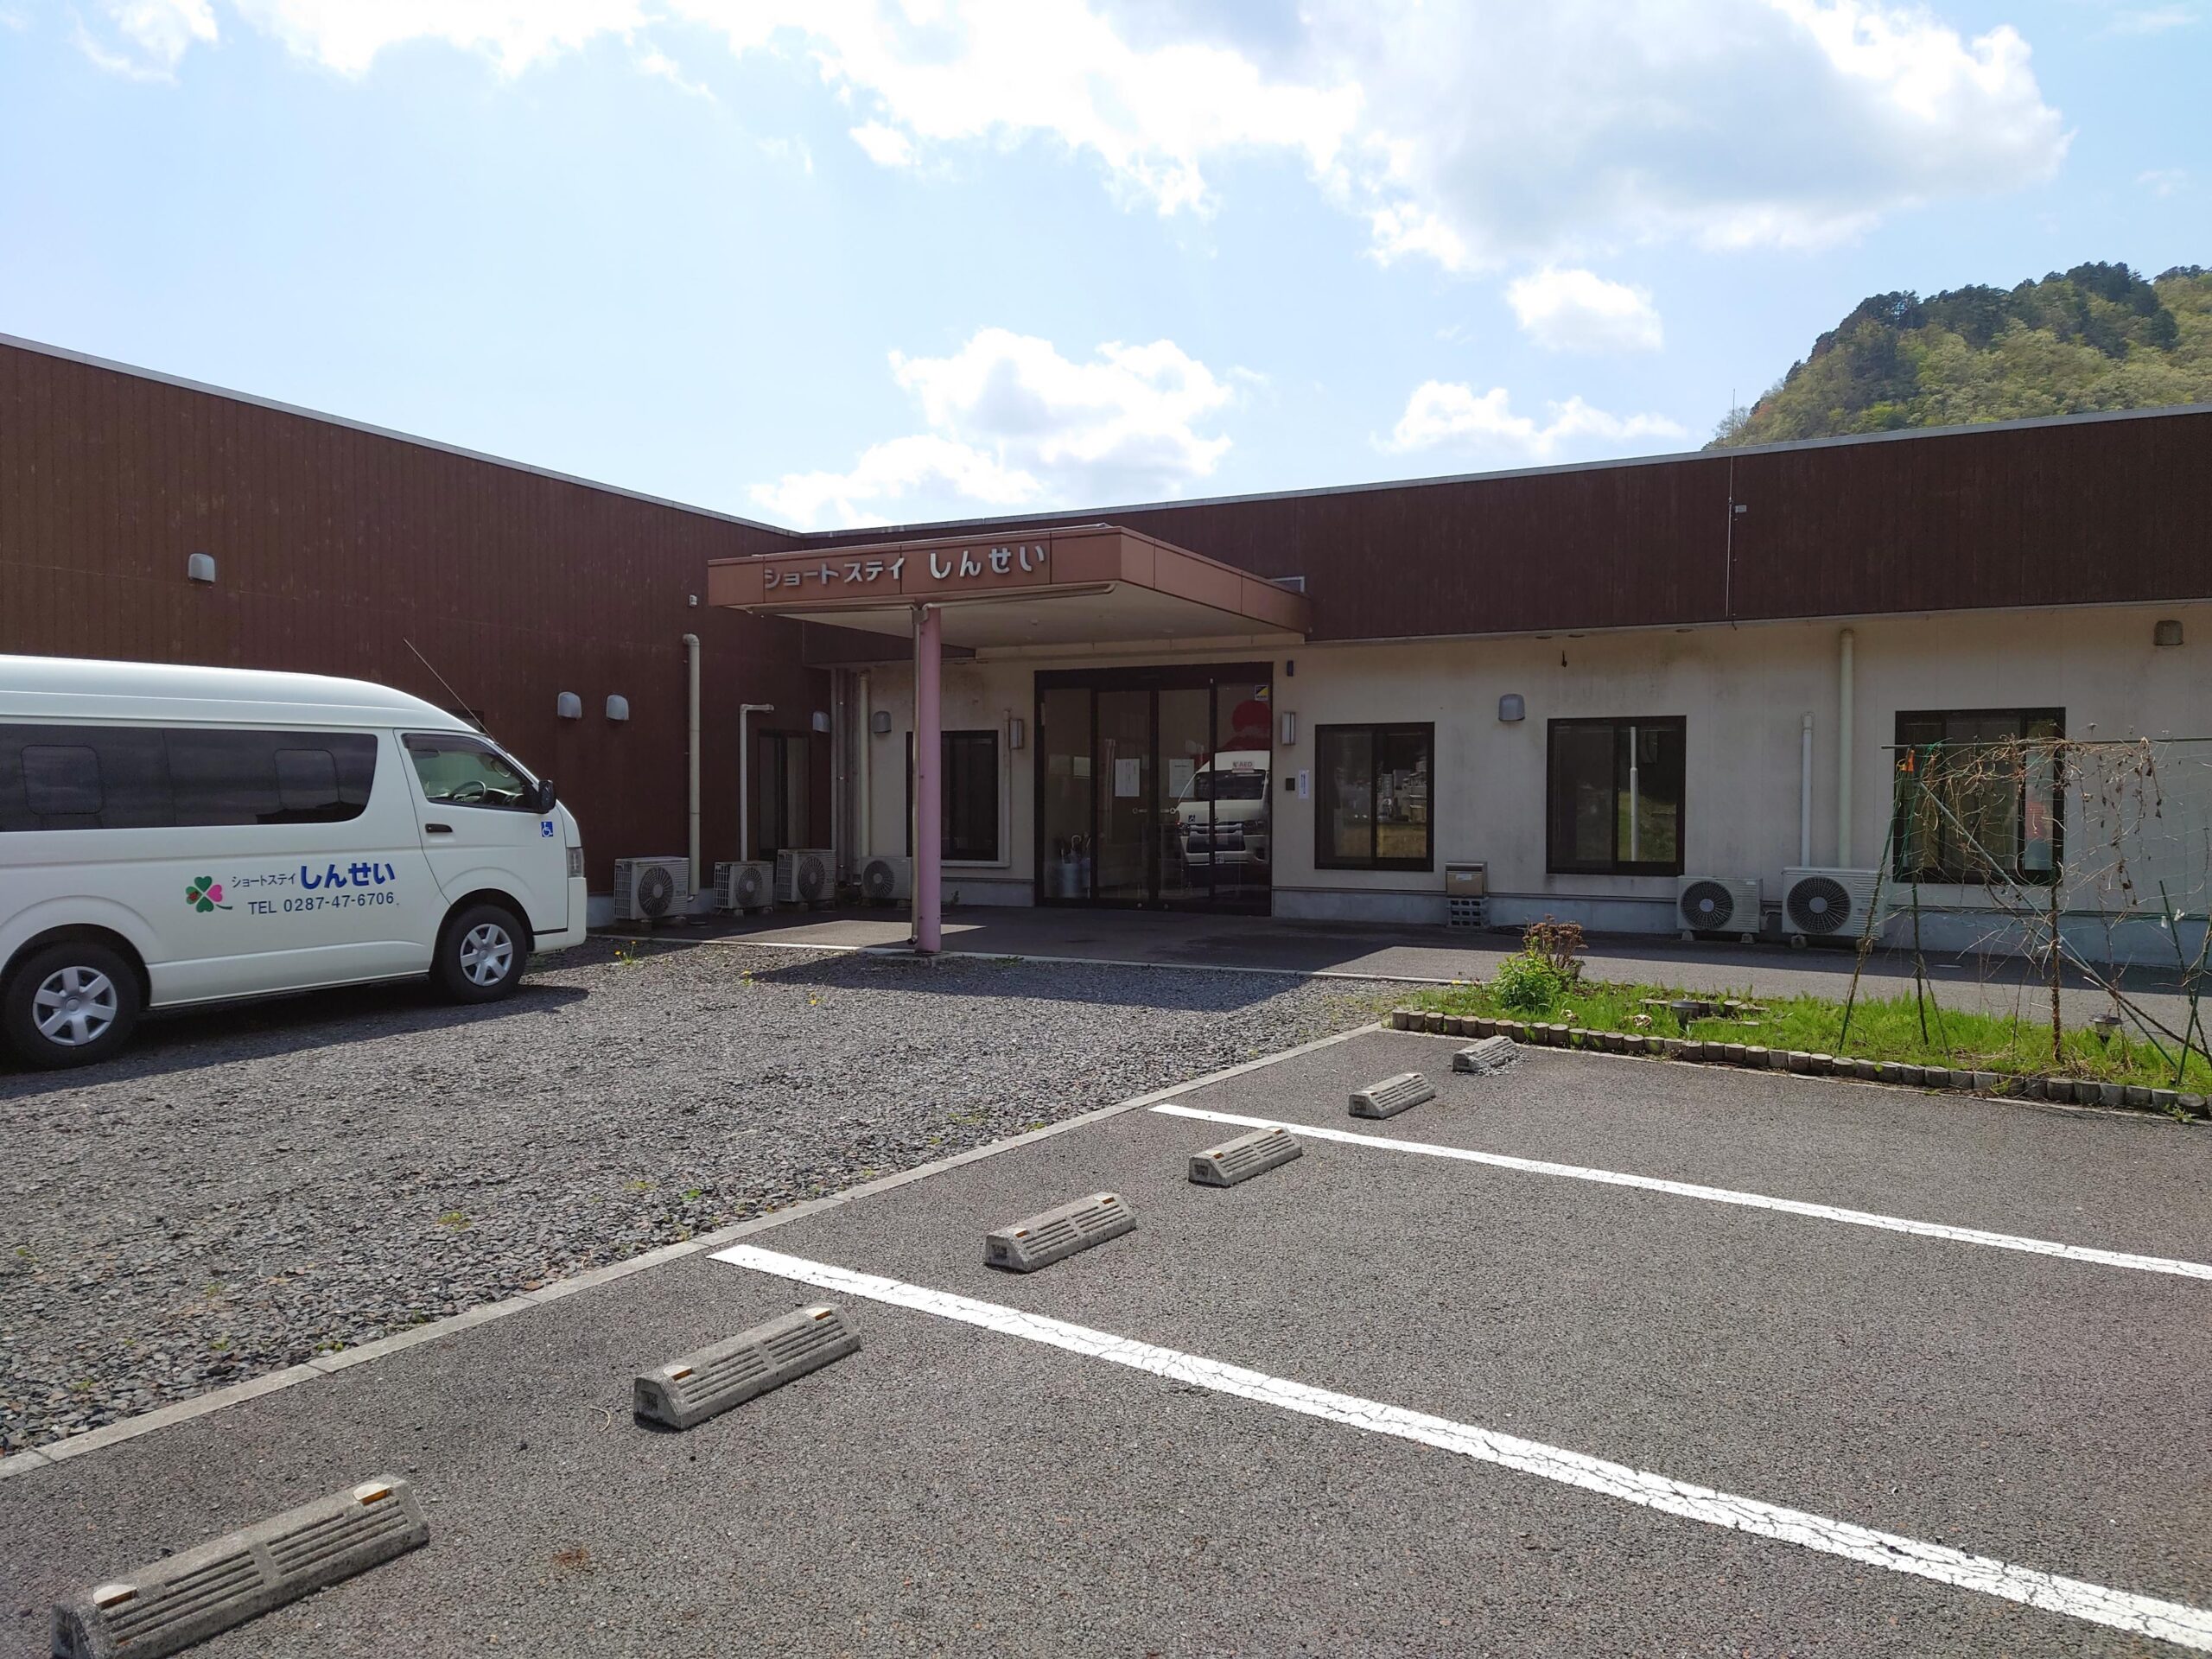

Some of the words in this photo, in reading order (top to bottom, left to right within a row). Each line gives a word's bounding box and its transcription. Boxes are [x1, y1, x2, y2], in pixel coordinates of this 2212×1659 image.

[764, 557, 906, 589] ショートステイ
[930, 545, 1045, 580] しんせい
[232, 873, 296, 888] ショートステイ
[301, 862, 396, 890] しんせい
[248, 900, 276, 915] TEL
[283, 892, 394, 912] 0287-47-6706
